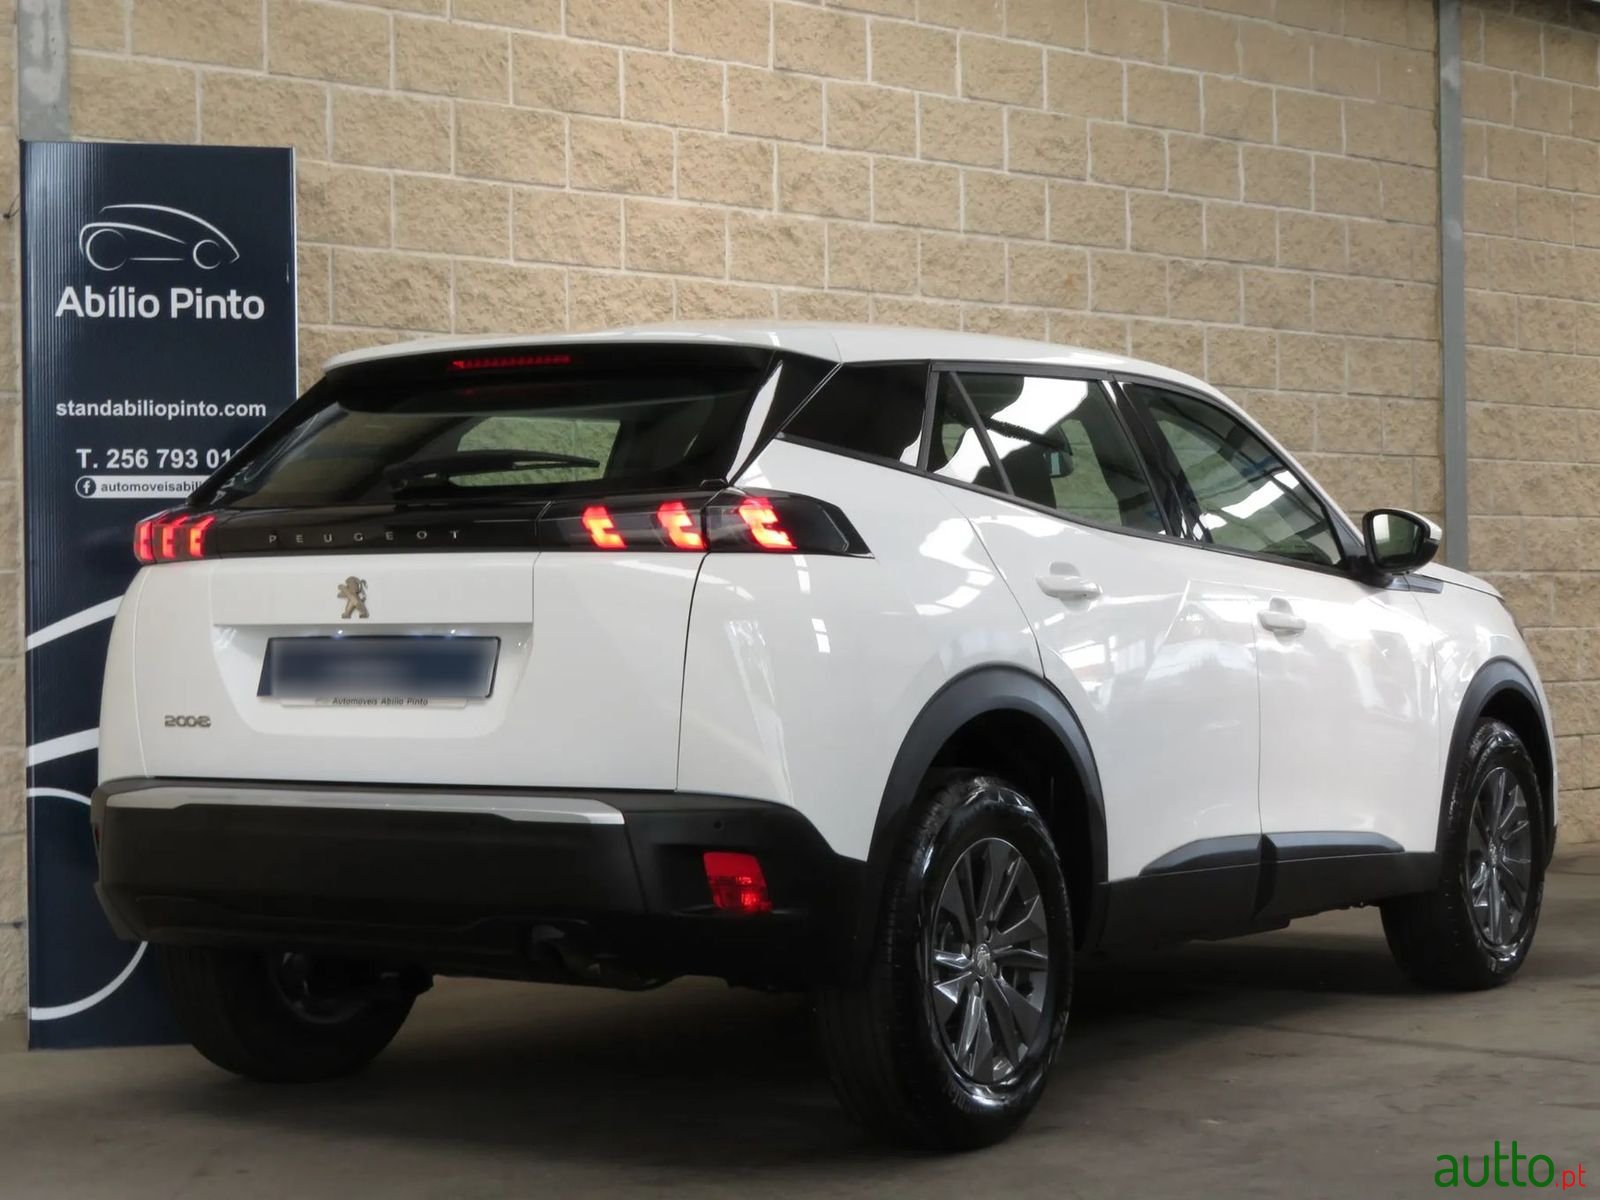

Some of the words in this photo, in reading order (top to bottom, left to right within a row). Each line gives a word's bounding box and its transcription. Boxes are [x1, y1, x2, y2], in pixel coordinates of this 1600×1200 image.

[55, 285, 160, 318] Abílio
[171, 287, 265, 320] Pinto
[56, 400, 267, 420] standabiliopinto.com
[76, 448, 98, 469] T.
[106, 448, 149, 469] 256
[156, 448, 199, 469] 793
[206, 448, 241, 469] 01
[269, 530, 459, 544] PEUGEOT
